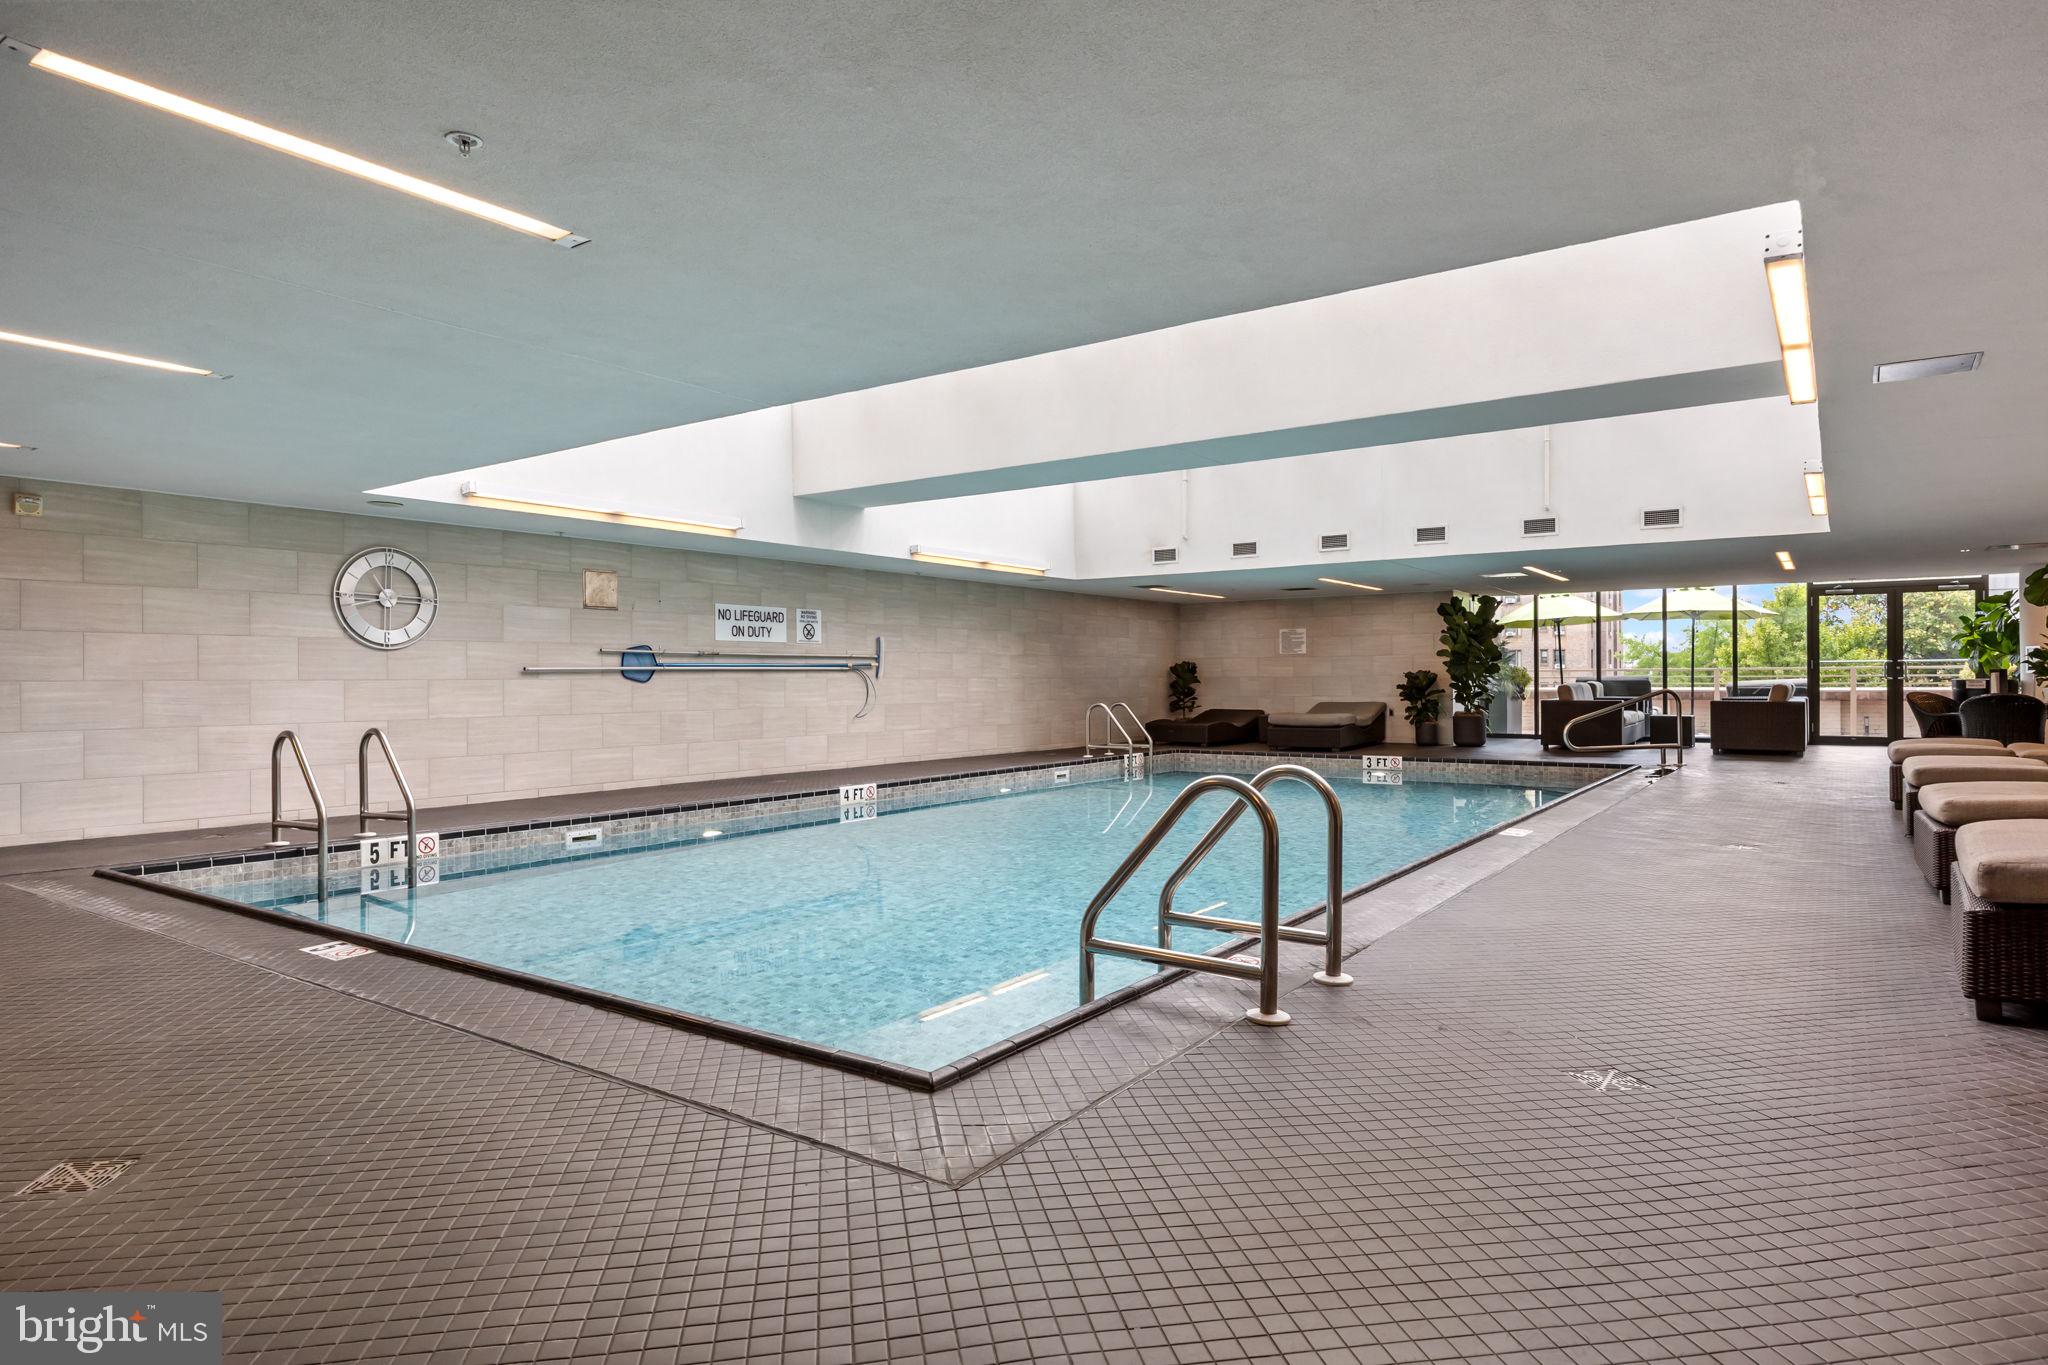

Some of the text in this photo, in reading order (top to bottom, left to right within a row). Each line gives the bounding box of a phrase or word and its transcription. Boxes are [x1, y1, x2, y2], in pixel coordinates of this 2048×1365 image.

[384, 552, 394, 566] 12
[718, 608, 785, 624] NO LIFEGUARD
[731, 625, 772, 638] ON DUTY
[1366, 757, 1388, 768] 3 FT
[844, 788, 864, 801] 4 FT
[369, 842, 380, 864] 5
